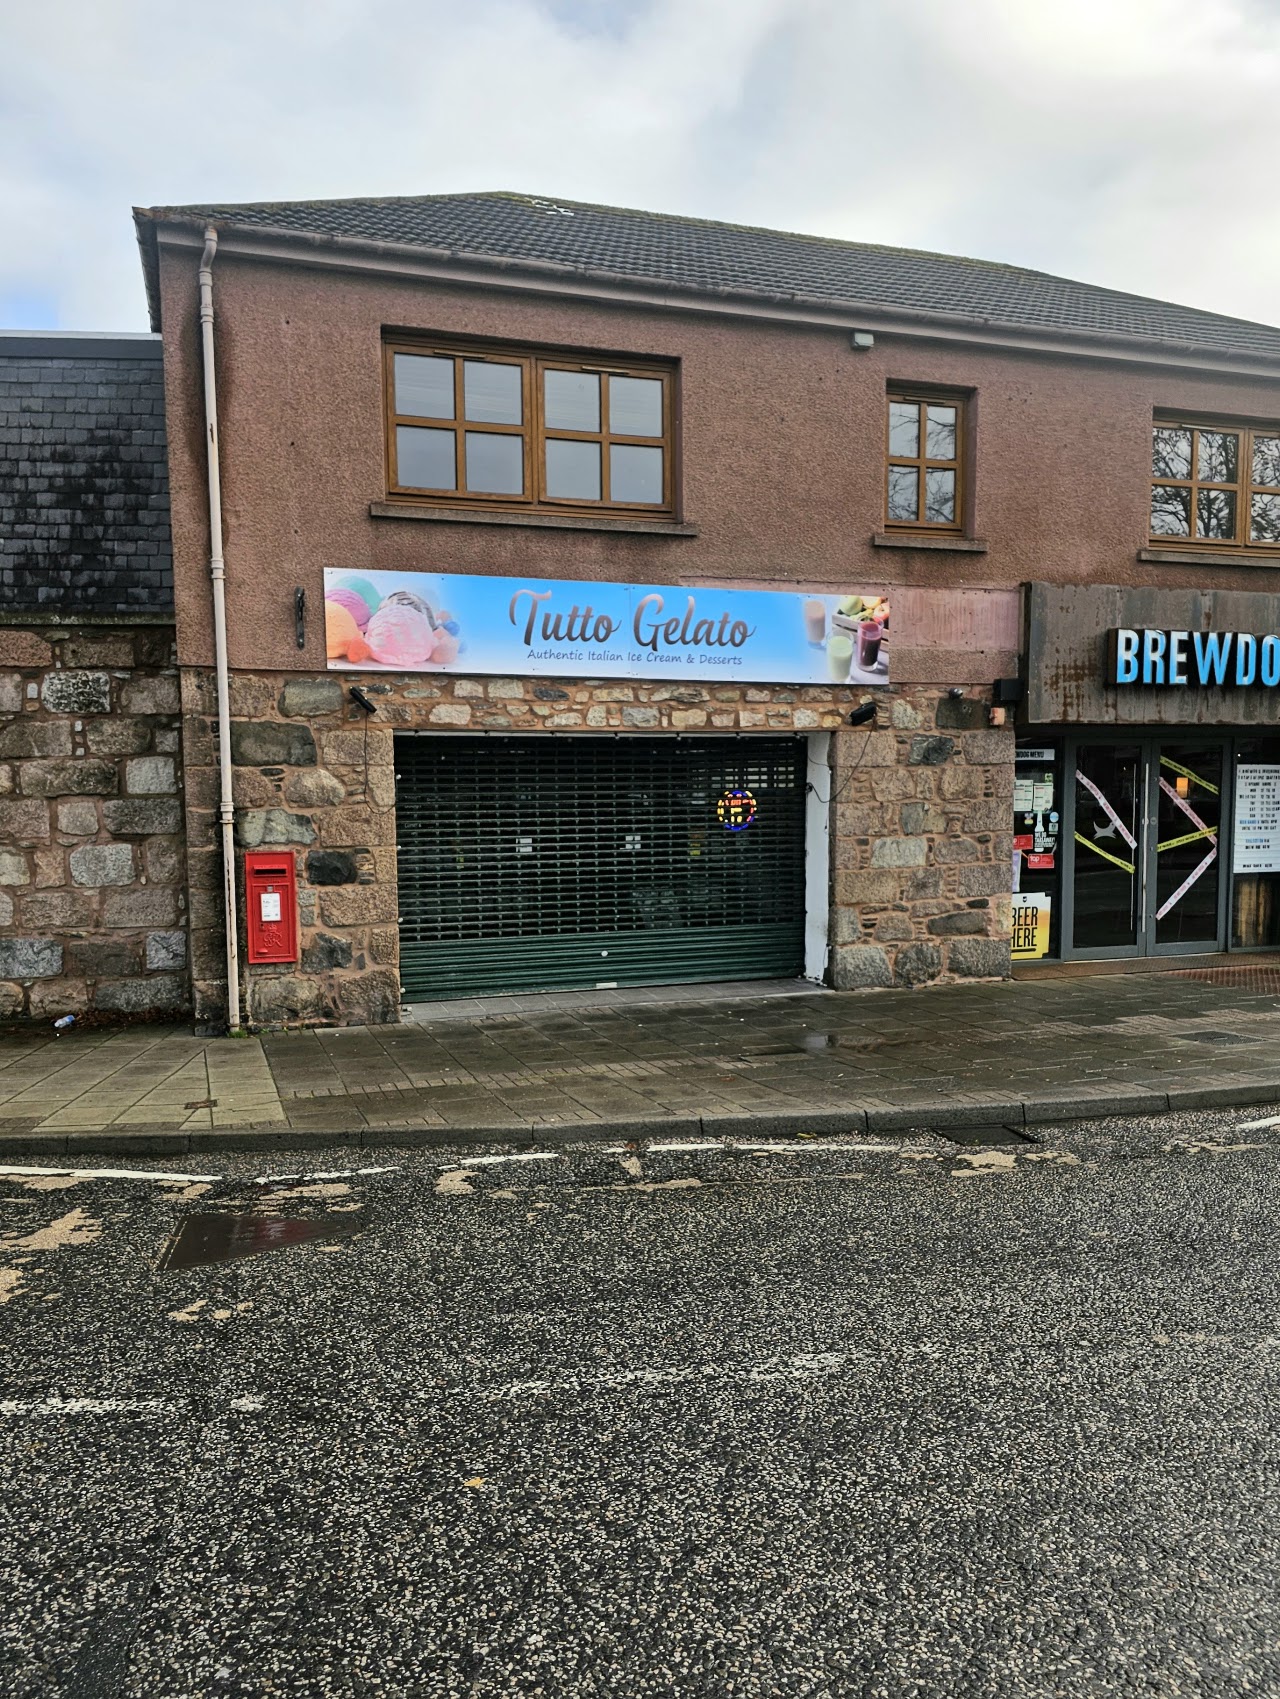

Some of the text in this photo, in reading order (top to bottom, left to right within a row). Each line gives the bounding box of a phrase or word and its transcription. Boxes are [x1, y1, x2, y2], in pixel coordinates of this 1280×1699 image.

[509, 589, 757, 652] Tutto Gelato
[527, 649, 743, 665] Authentic Italian Ice Cream & Desserts
[1116, 629, 1280, 686] BREWDO
